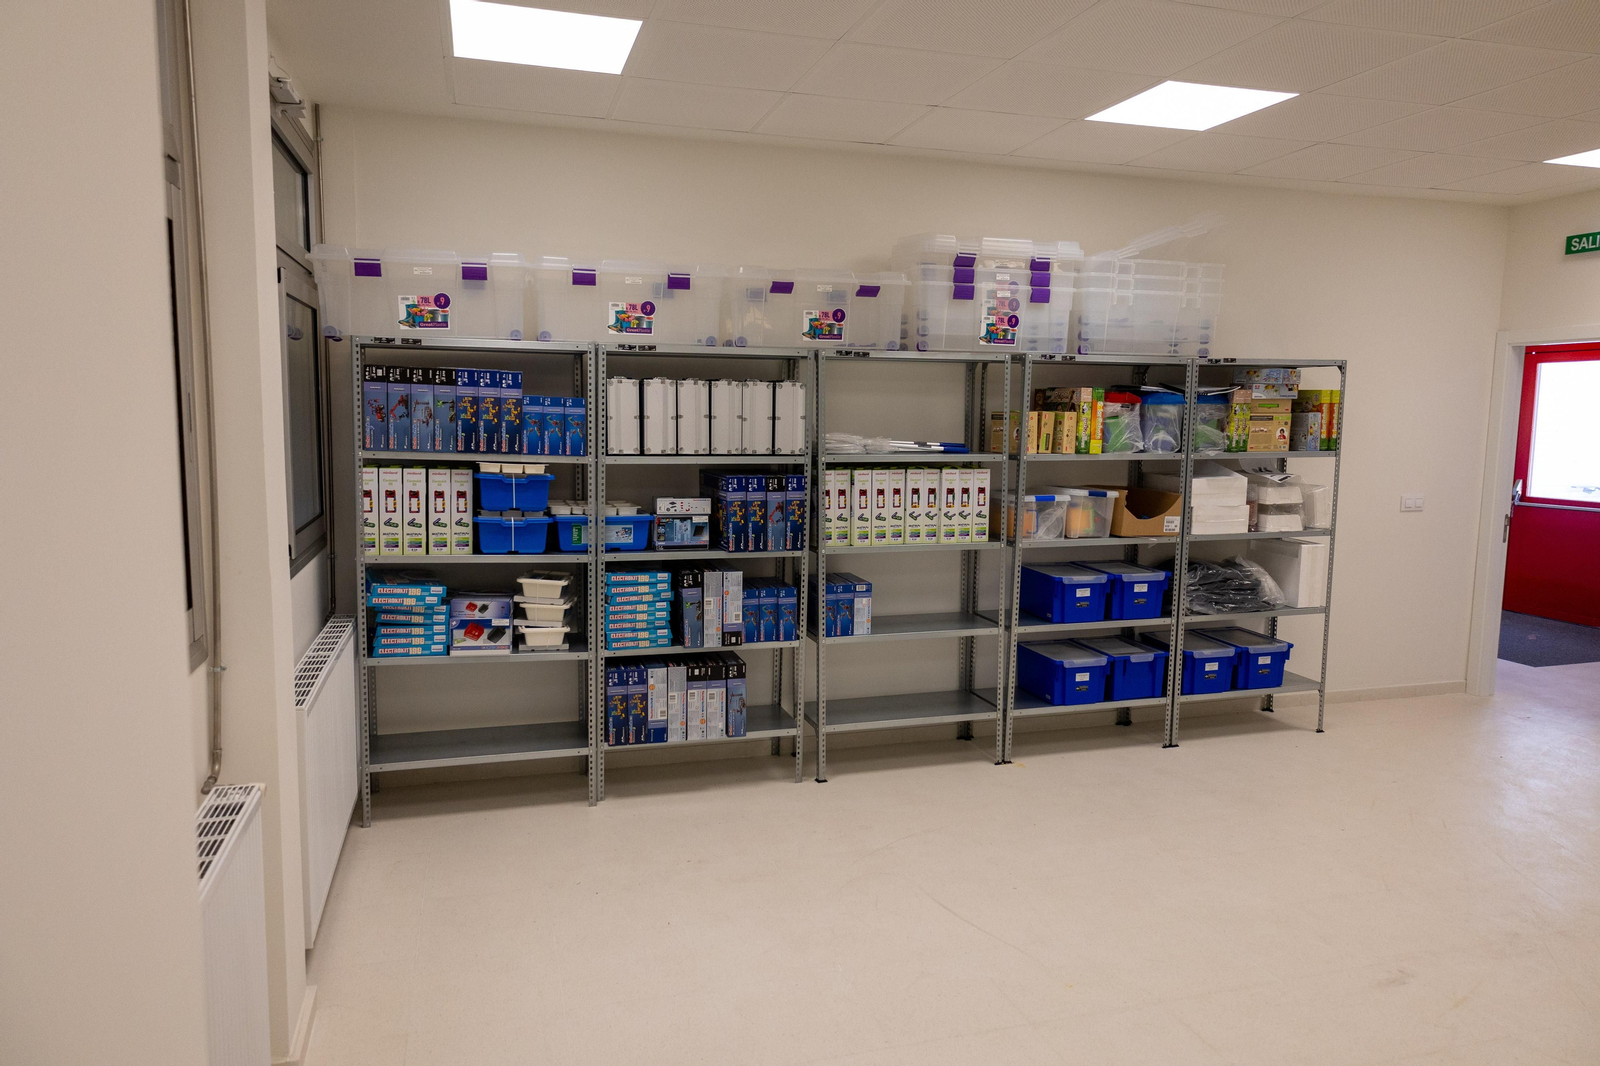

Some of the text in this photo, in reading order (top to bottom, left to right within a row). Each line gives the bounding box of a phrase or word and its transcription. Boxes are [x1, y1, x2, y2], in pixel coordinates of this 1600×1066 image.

[420, 296, 431, 304] 78L
[440, 296, 445, 306] 9
[646, 304, 651, 312] 9
